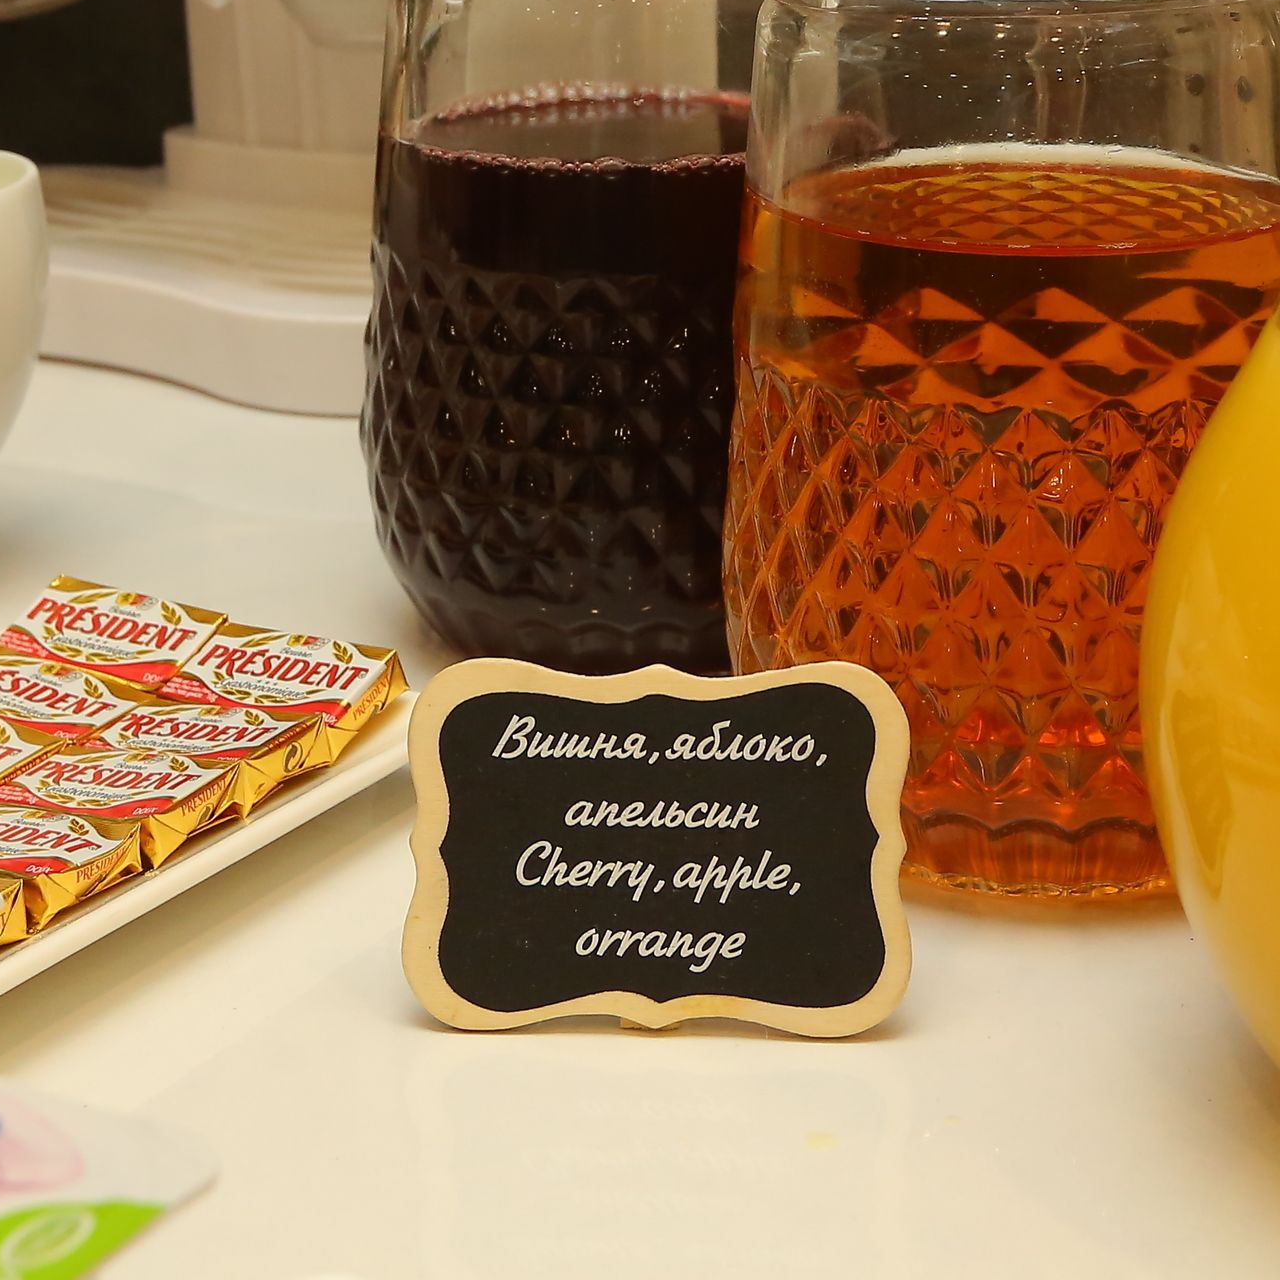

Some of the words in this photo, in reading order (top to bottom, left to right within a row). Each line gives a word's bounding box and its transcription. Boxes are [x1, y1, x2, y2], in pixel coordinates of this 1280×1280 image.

[27, 598, 197, 652] PRÉSIDENT
[197, 644, 369, 690] PRÉSIDENT
[492, 714, 660, 766] Вишня,
[664, 720, 828, 767] яблоко,
[25, 760, 202, 791] PRÉSIDENT
[564, 798, 759, 830] апельсин
[515, 840, 665, 902] Cherry,
[672, 850, 802, 904] apple,
[575, 926, 746, 974] orrange
